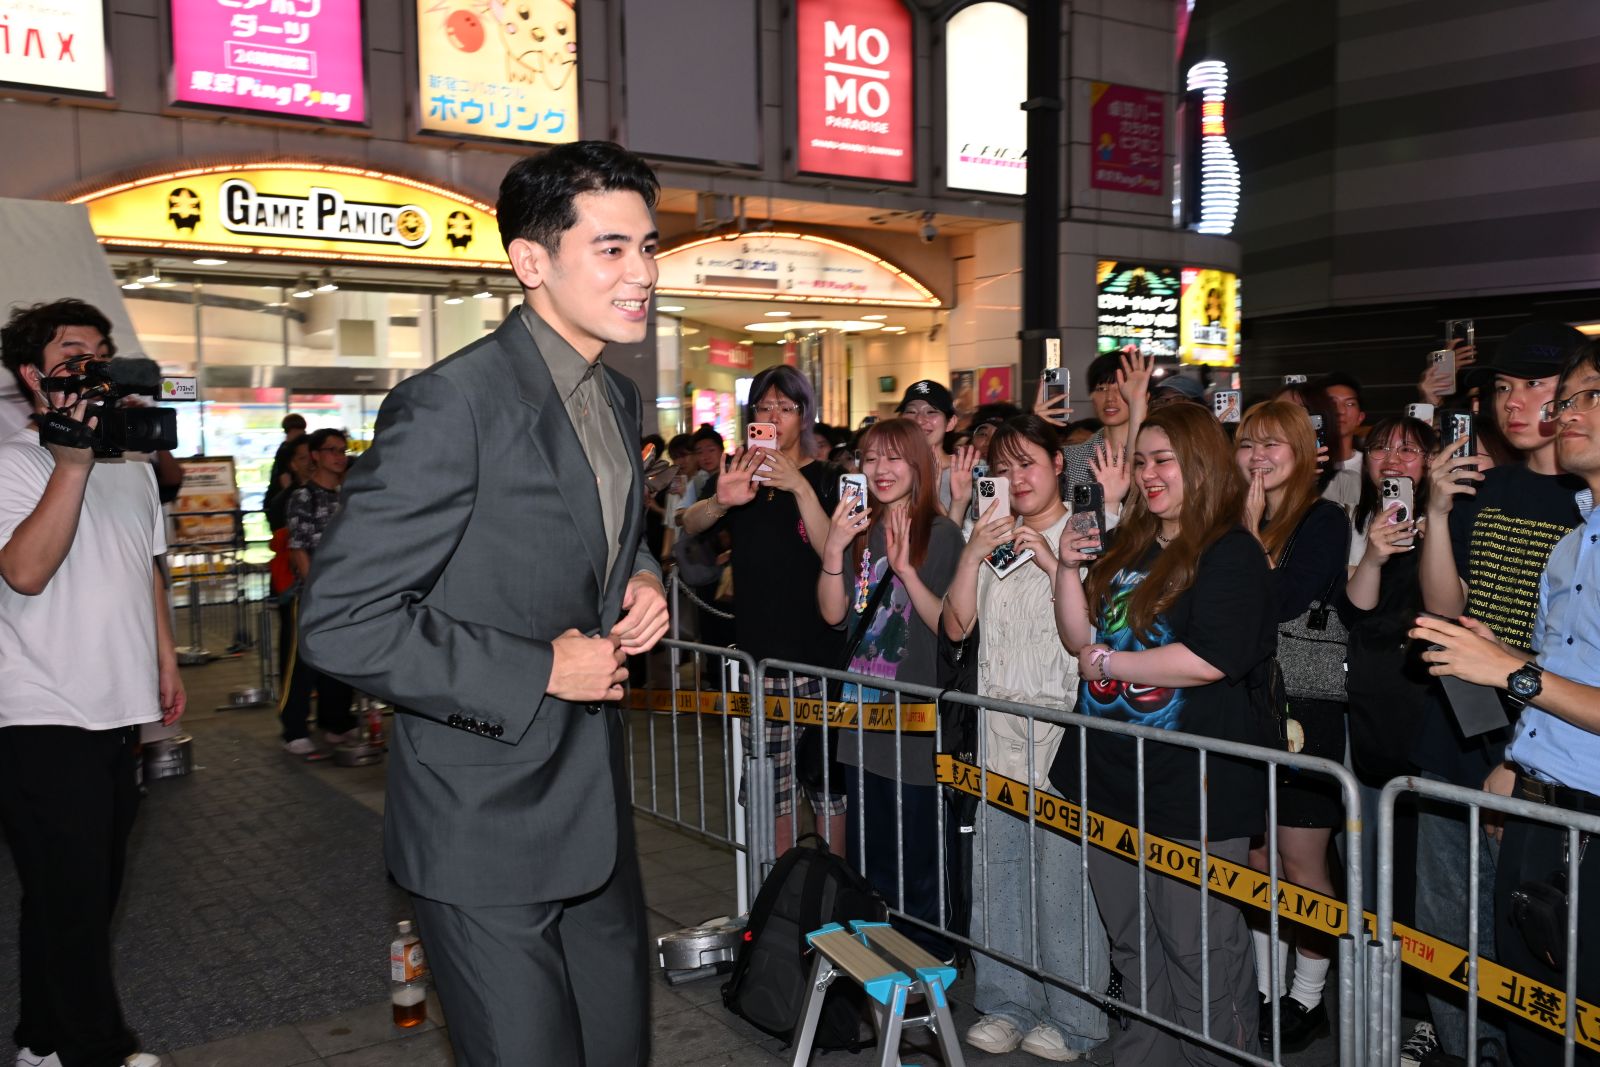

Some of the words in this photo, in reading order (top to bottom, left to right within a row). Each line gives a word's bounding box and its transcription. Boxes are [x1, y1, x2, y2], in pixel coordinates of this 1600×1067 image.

[230, 14, 309, 44] ダーツ
[824, 20, 890, 65] MO
[824, 75, 890, 117] MO
[825, 115, 890, 134] PARADISE
[227, 184, 304, 230] GAME
[317, 192, 393, 236] PANIC
[50, 421, 71, 433] SONY
